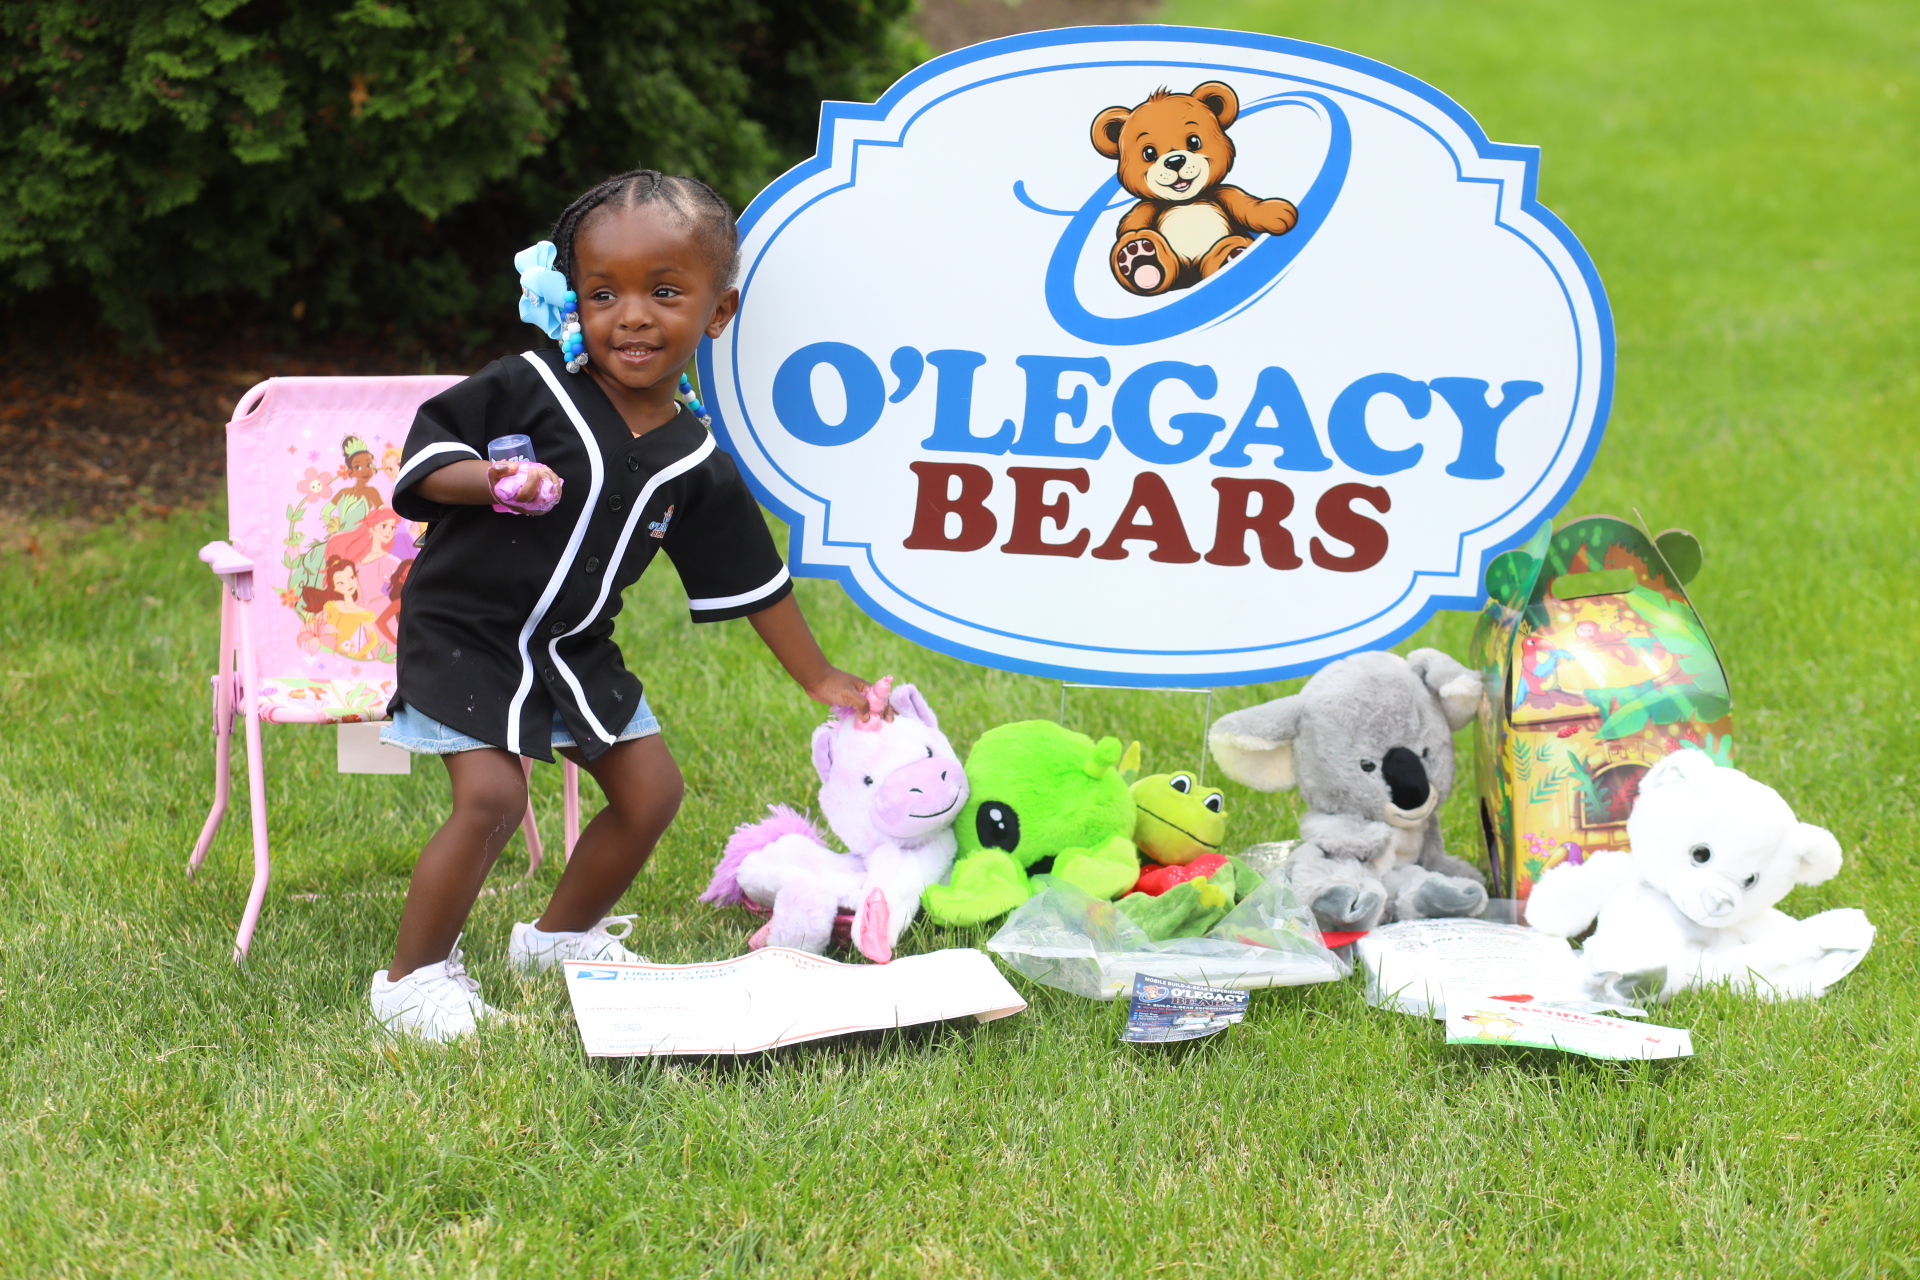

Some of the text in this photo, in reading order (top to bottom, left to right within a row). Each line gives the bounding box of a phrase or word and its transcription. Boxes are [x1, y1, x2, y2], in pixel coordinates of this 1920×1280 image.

[772, 341, 1543, 480] O'LEGACY
[903, 461, 1391, 573] BEARS
[1144, 976, 1167, 986] MOBILE
[1209, 986, 1245, 995] EXPERIENCE
[1170, 987, 1246, 1003] O'LEGACY
[1171, 996, 1237, 1008] BEARS
[1509, 1006, 1628, 1030] CERTIFICATE
